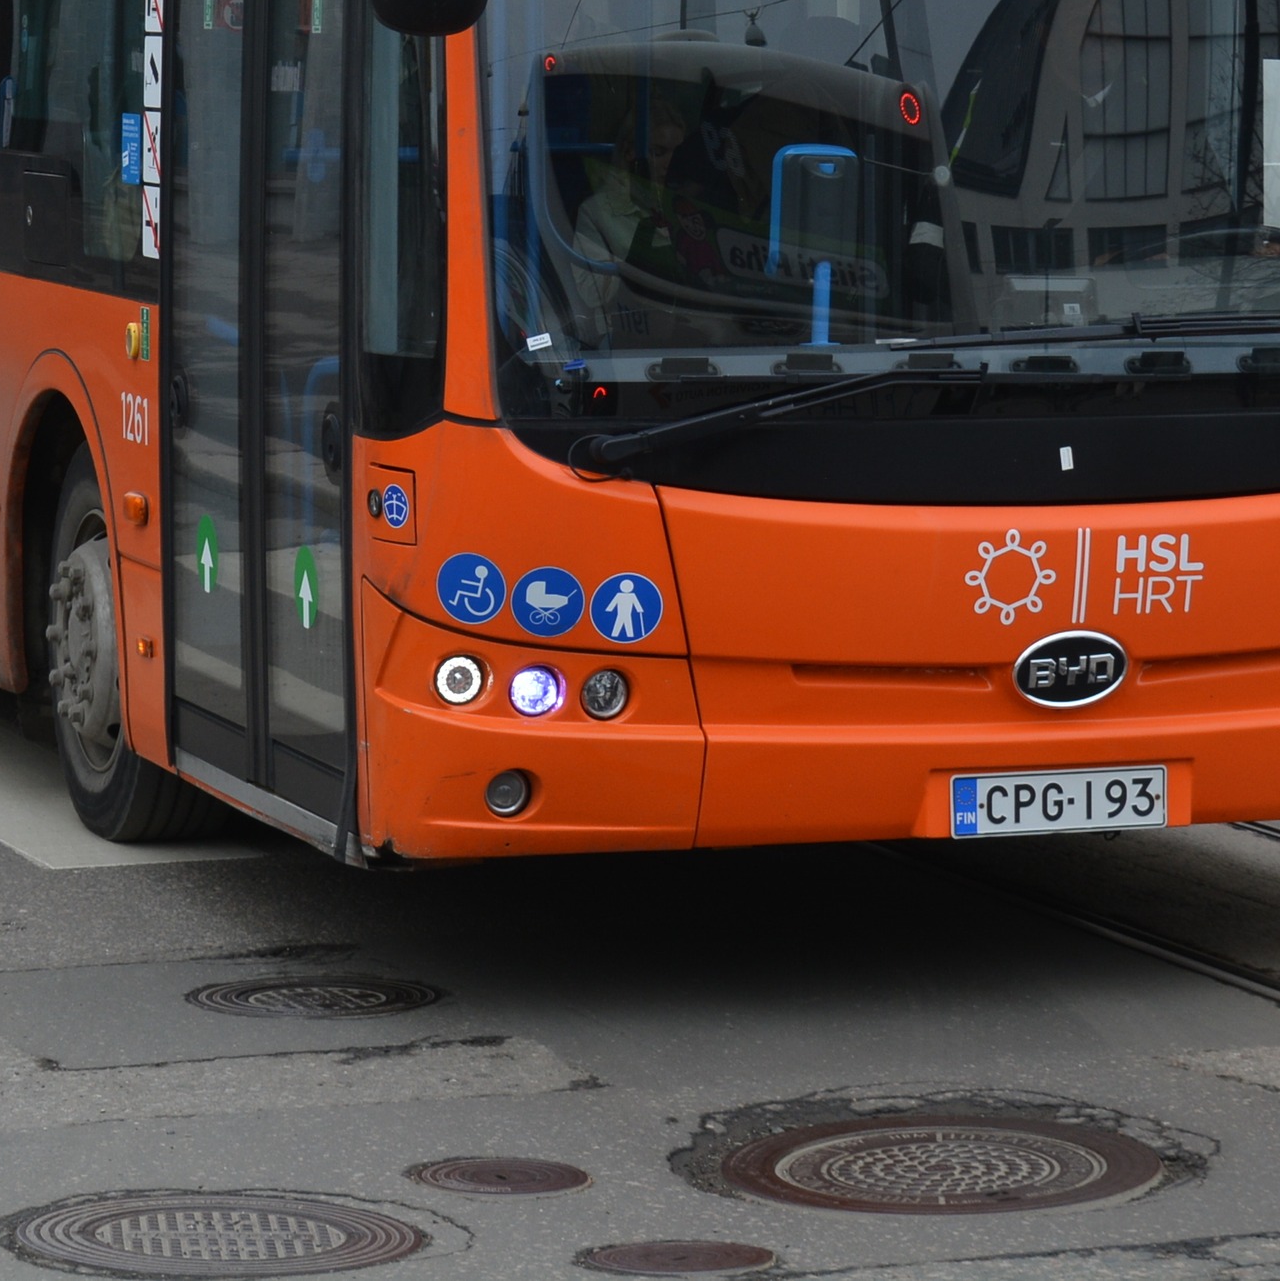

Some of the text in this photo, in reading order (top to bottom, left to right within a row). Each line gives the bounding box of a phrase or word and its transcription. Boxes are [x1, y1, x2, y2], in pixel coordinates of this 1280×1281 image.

[120, 391, 149, 446] 1261
[1116, 533, 1205, 574] HSL
[1112, 574, 1204, 615] HRT
[1027, 652, 1116, 689] BYD
[956, 776, 1156, 825] FIN CPG-193
